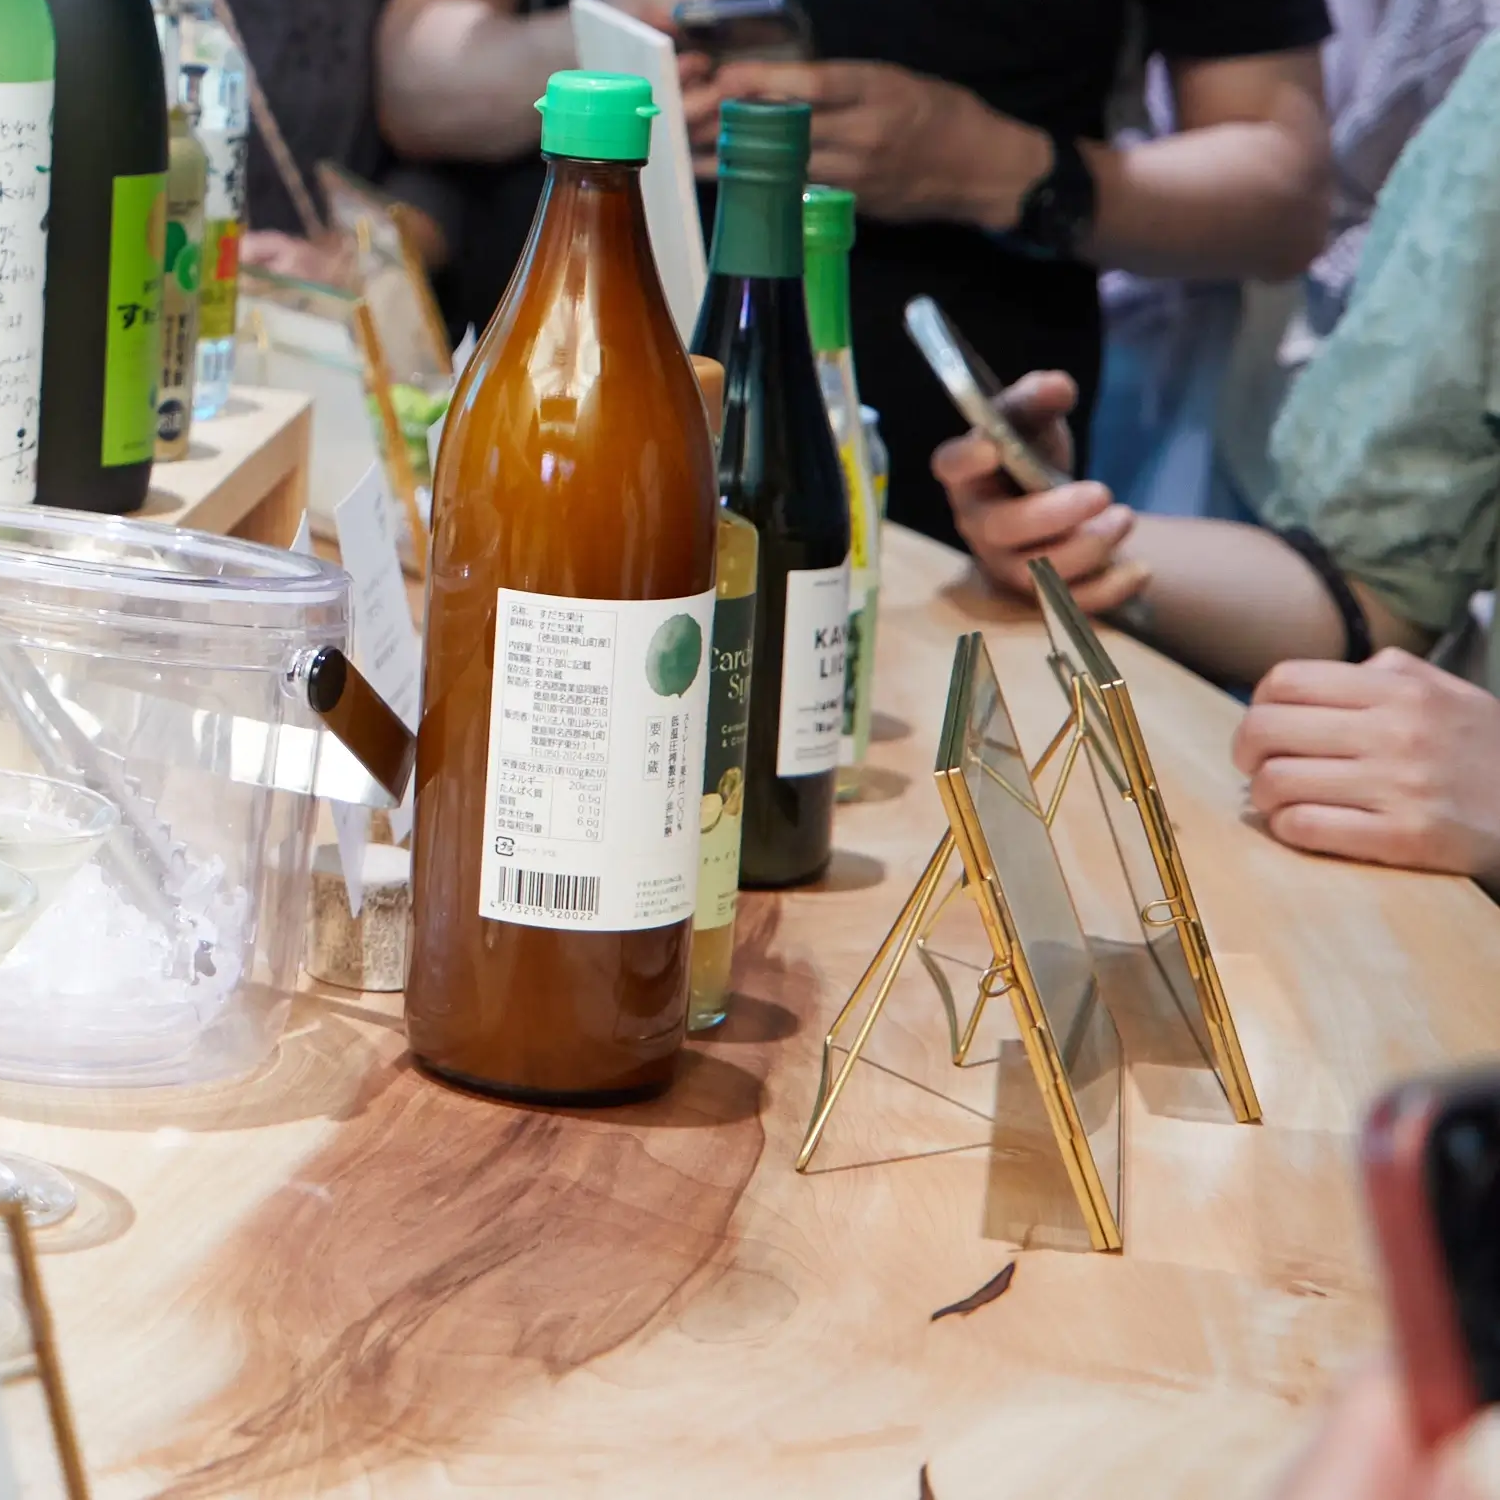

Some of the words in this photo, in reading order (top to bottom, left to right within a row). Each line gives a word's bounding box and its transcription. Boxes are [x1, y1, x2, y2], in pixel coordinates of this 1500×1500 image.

[540, 609, 585, 622] すだち果汁
[539, 621, 585, 634] すだち果実
[646, 721, 661, 775] 要冷蔵
[501, 771, 545, 785] エネルギー
[500, 783, 543, 799] たんぱく質
[501, 904, 544, 917] 573215
[549, 910, 594, 921] 520022
